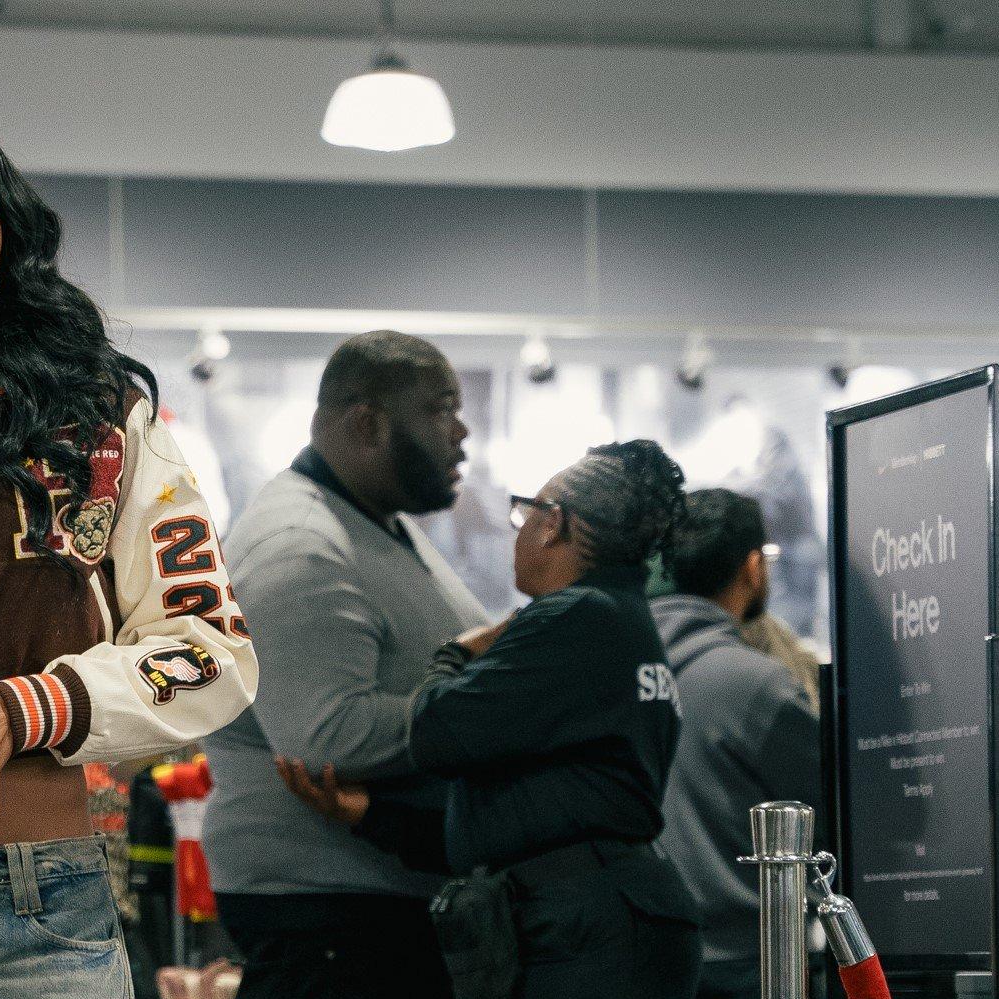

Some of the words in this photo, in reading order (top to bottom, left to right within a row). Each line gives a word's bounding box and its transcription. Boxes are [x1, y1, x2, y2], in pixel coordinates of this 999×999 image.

[102, 450, 120, 459] RED
[871, 519, 933, 578] Check
[937, 514, 956, 564] In
[892, 590, 941, 641] Here
[148, 670, 168, 688] MVP
